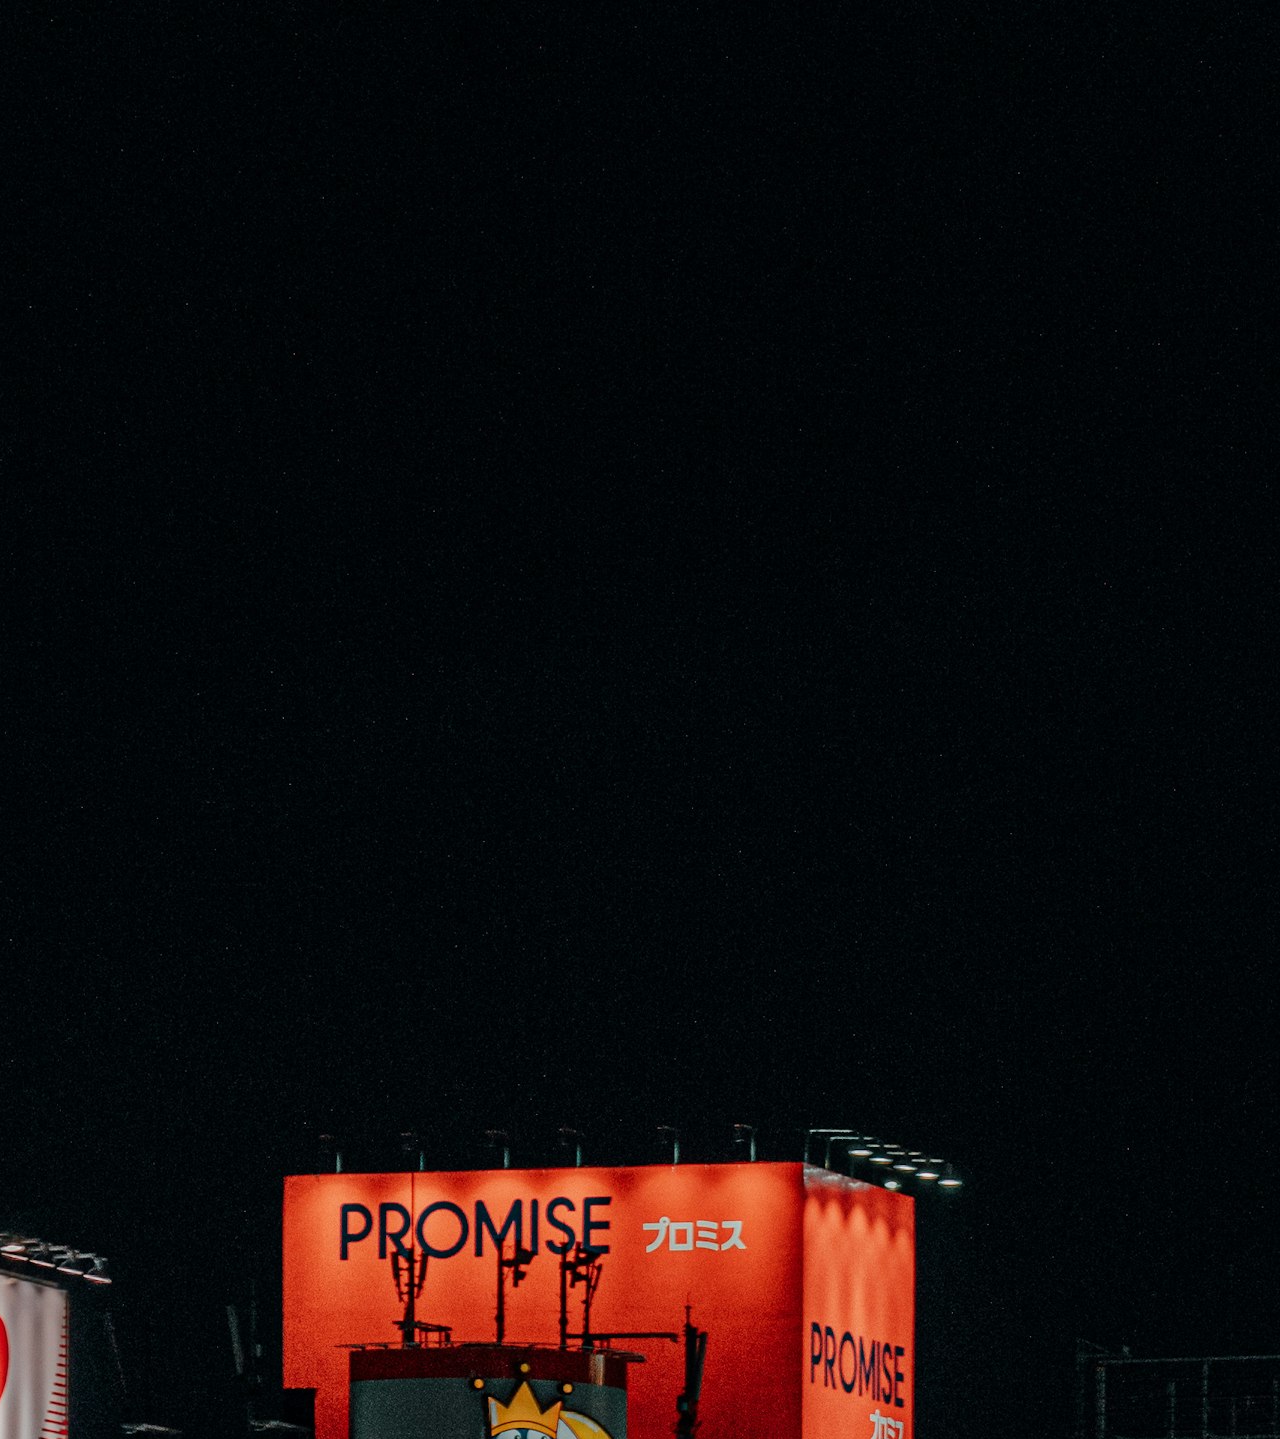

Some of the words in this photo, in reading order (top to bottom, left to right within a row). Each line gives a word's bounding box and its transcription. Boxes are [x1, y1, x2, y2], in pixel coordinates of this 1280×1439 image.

[340, 1195, 614, 1261] PROMISE
[642, 1216, 748, 1254] プロミス
[810, 1321, 906, 1409] PROMISE
